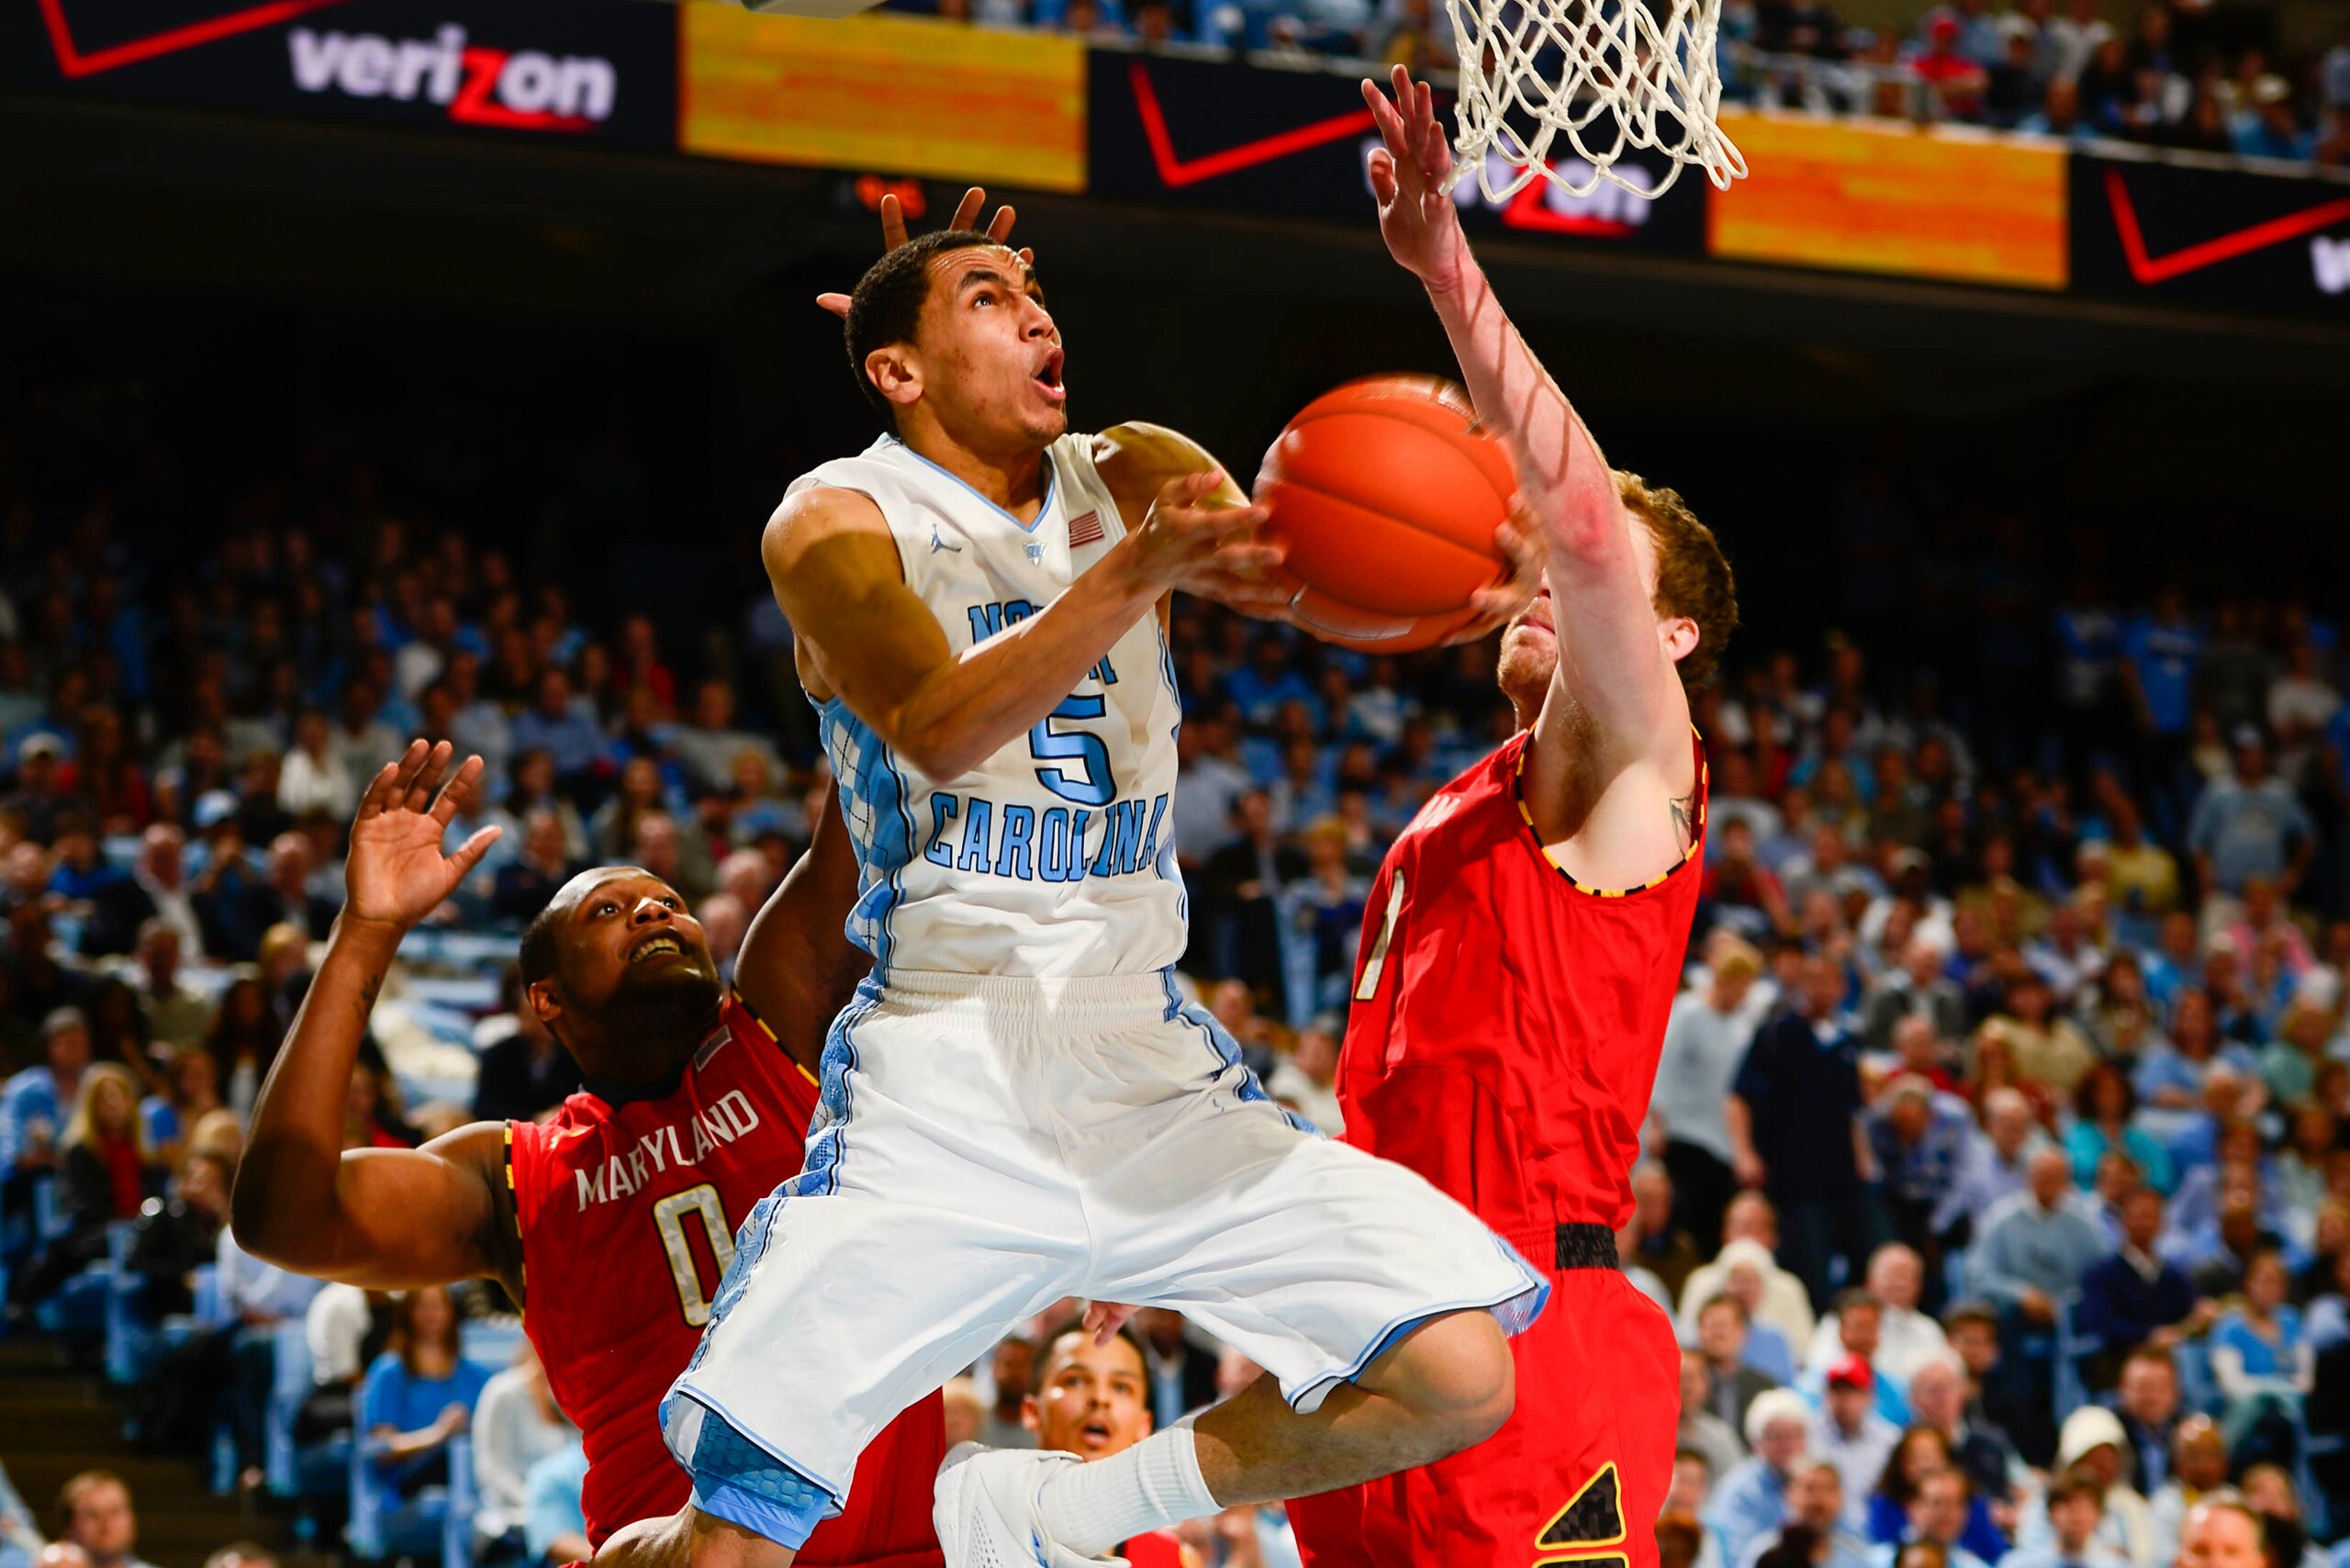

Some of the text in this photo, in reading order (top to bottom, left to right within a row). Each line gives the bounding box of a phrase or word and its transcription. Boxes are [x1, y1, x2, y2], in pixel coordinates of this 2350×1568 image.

[288, 23, 617, 129] verizon
[1029, 694, 1118, 806] 5
[923, 792, 1169, 882] CAROLINA
[576, 1090, 760, 1212] MARYLAND
[653, 1183, 736, 1327] 0
